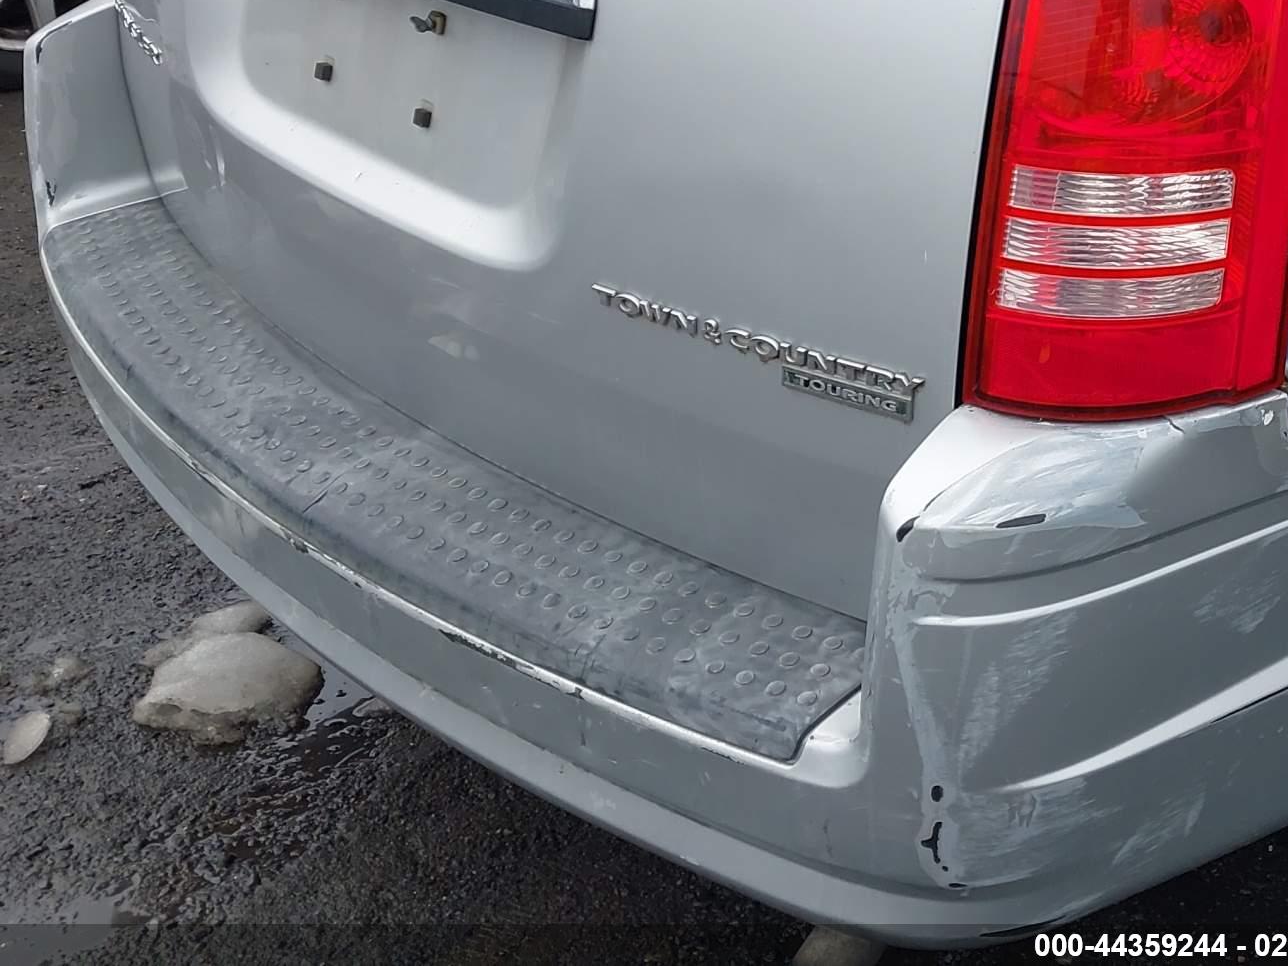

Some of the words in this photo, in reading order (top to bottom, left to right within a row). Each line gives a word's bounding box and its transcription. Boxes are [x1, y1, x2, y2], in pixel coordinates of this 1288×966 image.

[591, 282, 698, 338] TOWN
[725, 326, 925, 392] COUNTRY
[798, 374, 898, 413] TOURING
